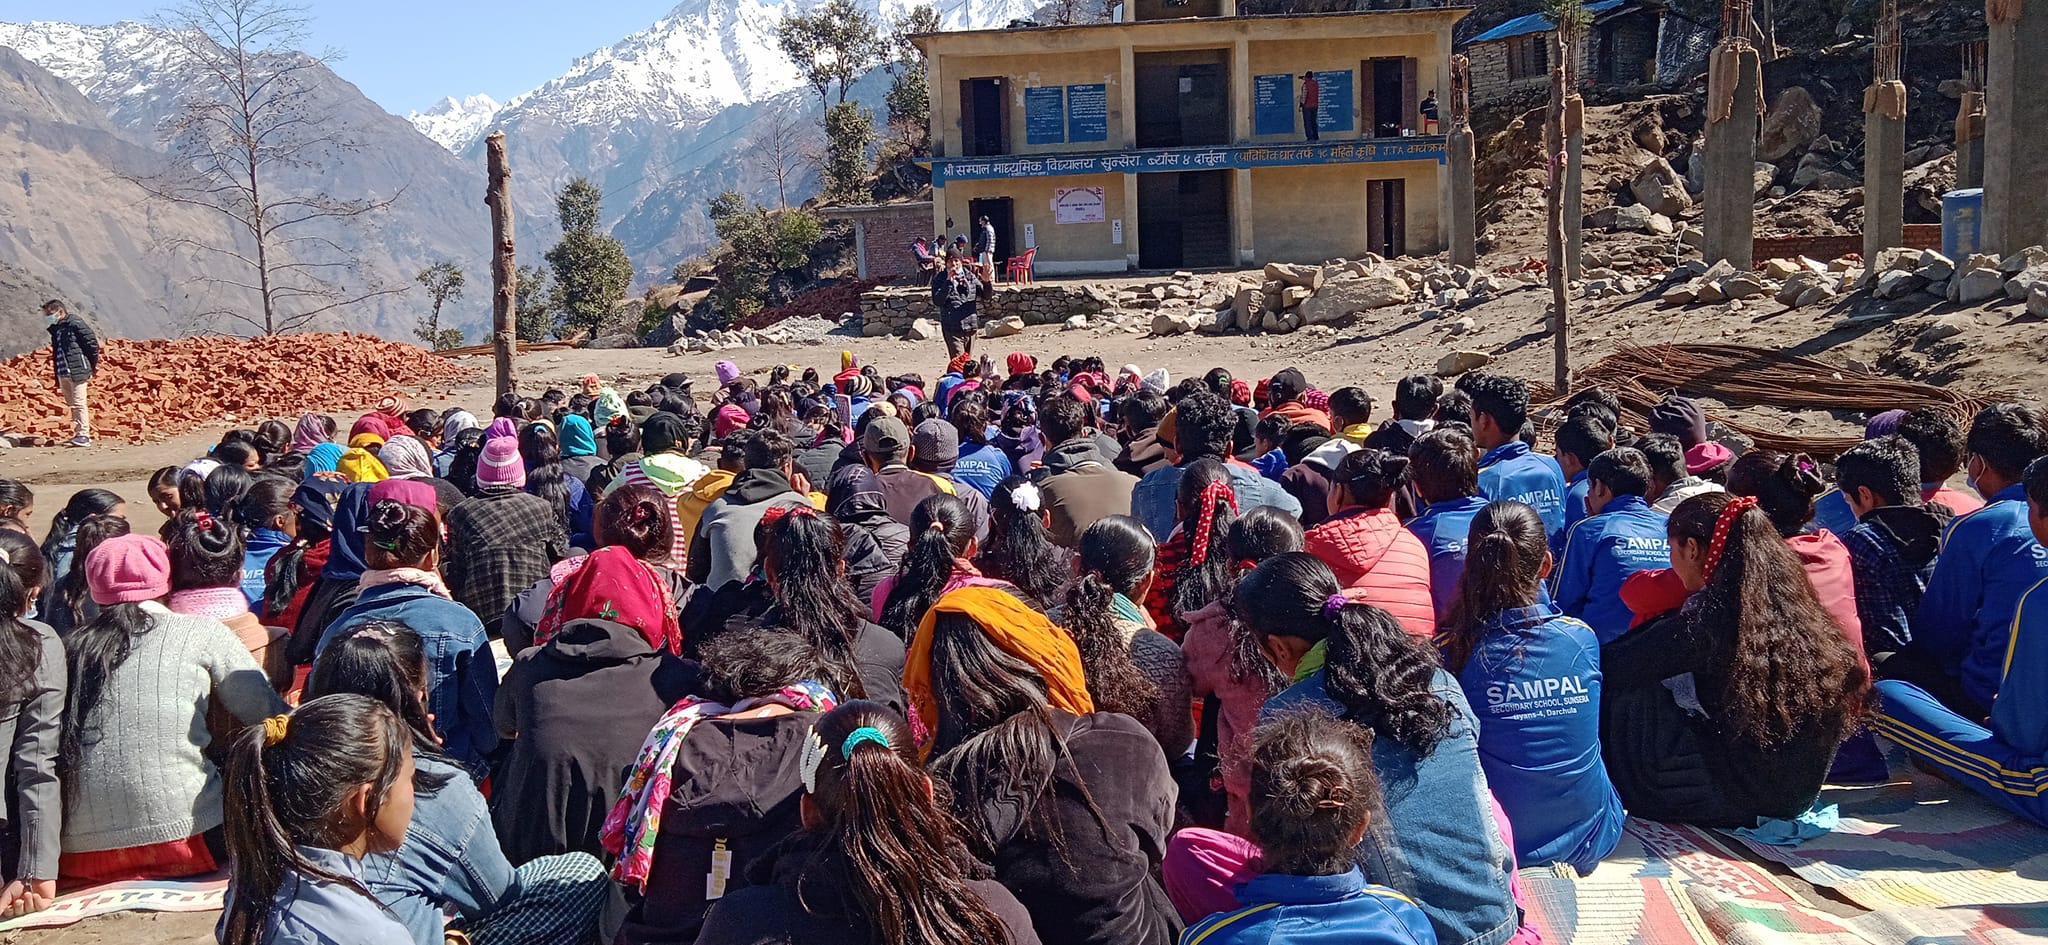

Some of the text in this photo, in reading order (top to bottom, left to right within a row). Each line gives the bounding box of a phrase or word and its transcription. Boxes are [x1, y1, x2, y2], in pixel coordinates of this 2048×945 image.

[943, 163, 954, 176] श्री
[956, 164, 991, 176] सम्पाल
[993, 159, 1042, 175] माध्यमिक
[956, 460, 991, 470] AMPAL
[1508, 489, 1560, 505] AMPAL
[1615, 536, 1671, 551] SAMPA
[1486, 675, 1588, 705] SAMPAL
[1491, 695, 1590, 714] SECONDARY SCHOOL, SUNSERA
[1547, 707, 1577, 716] Darchula
